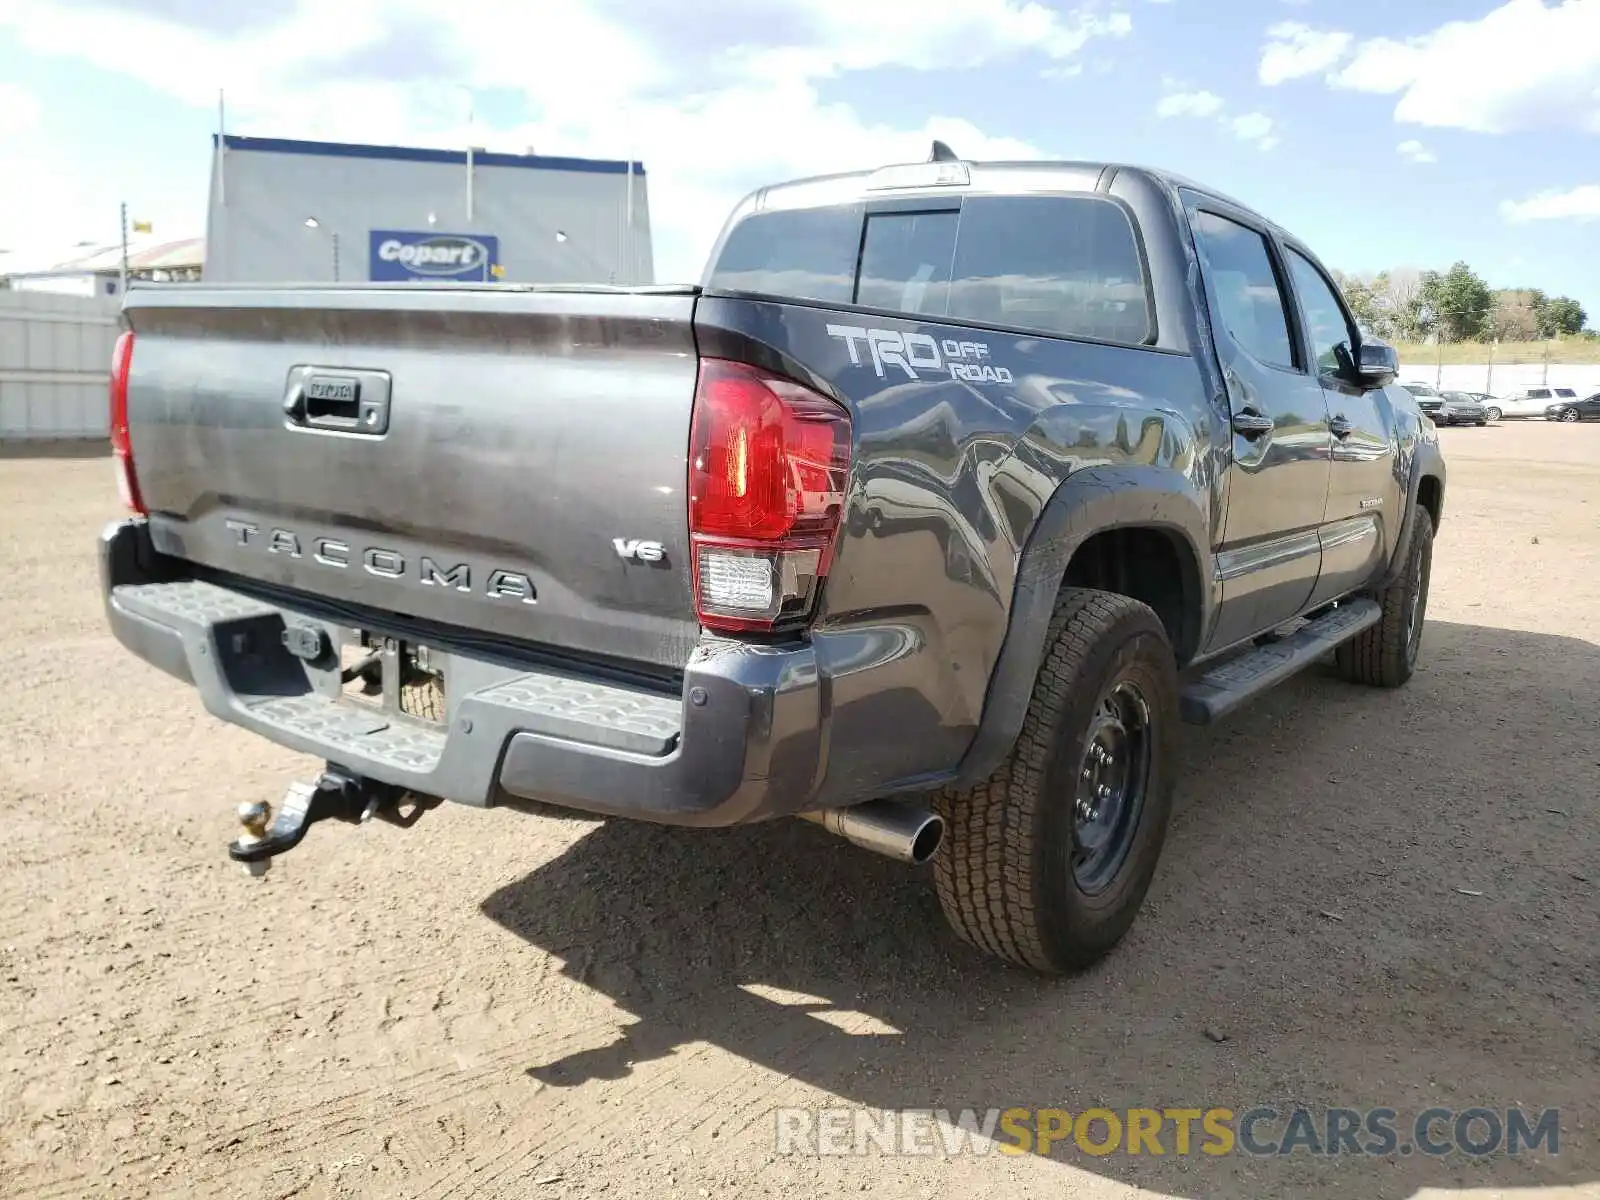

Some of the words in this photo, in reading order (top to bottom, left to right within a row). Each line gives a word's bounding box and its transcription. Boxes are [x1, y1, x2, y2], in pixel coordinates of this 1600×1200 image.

[378, 239, 474, 265] Copart
[826, 324, 941, 379] TRD
[941, 339, 989, 358] OFF
[948, 362, 1014, 384] ROAD
[225, 517, 537, 604] TACOMA
[612, 537, 667, 561] V6
